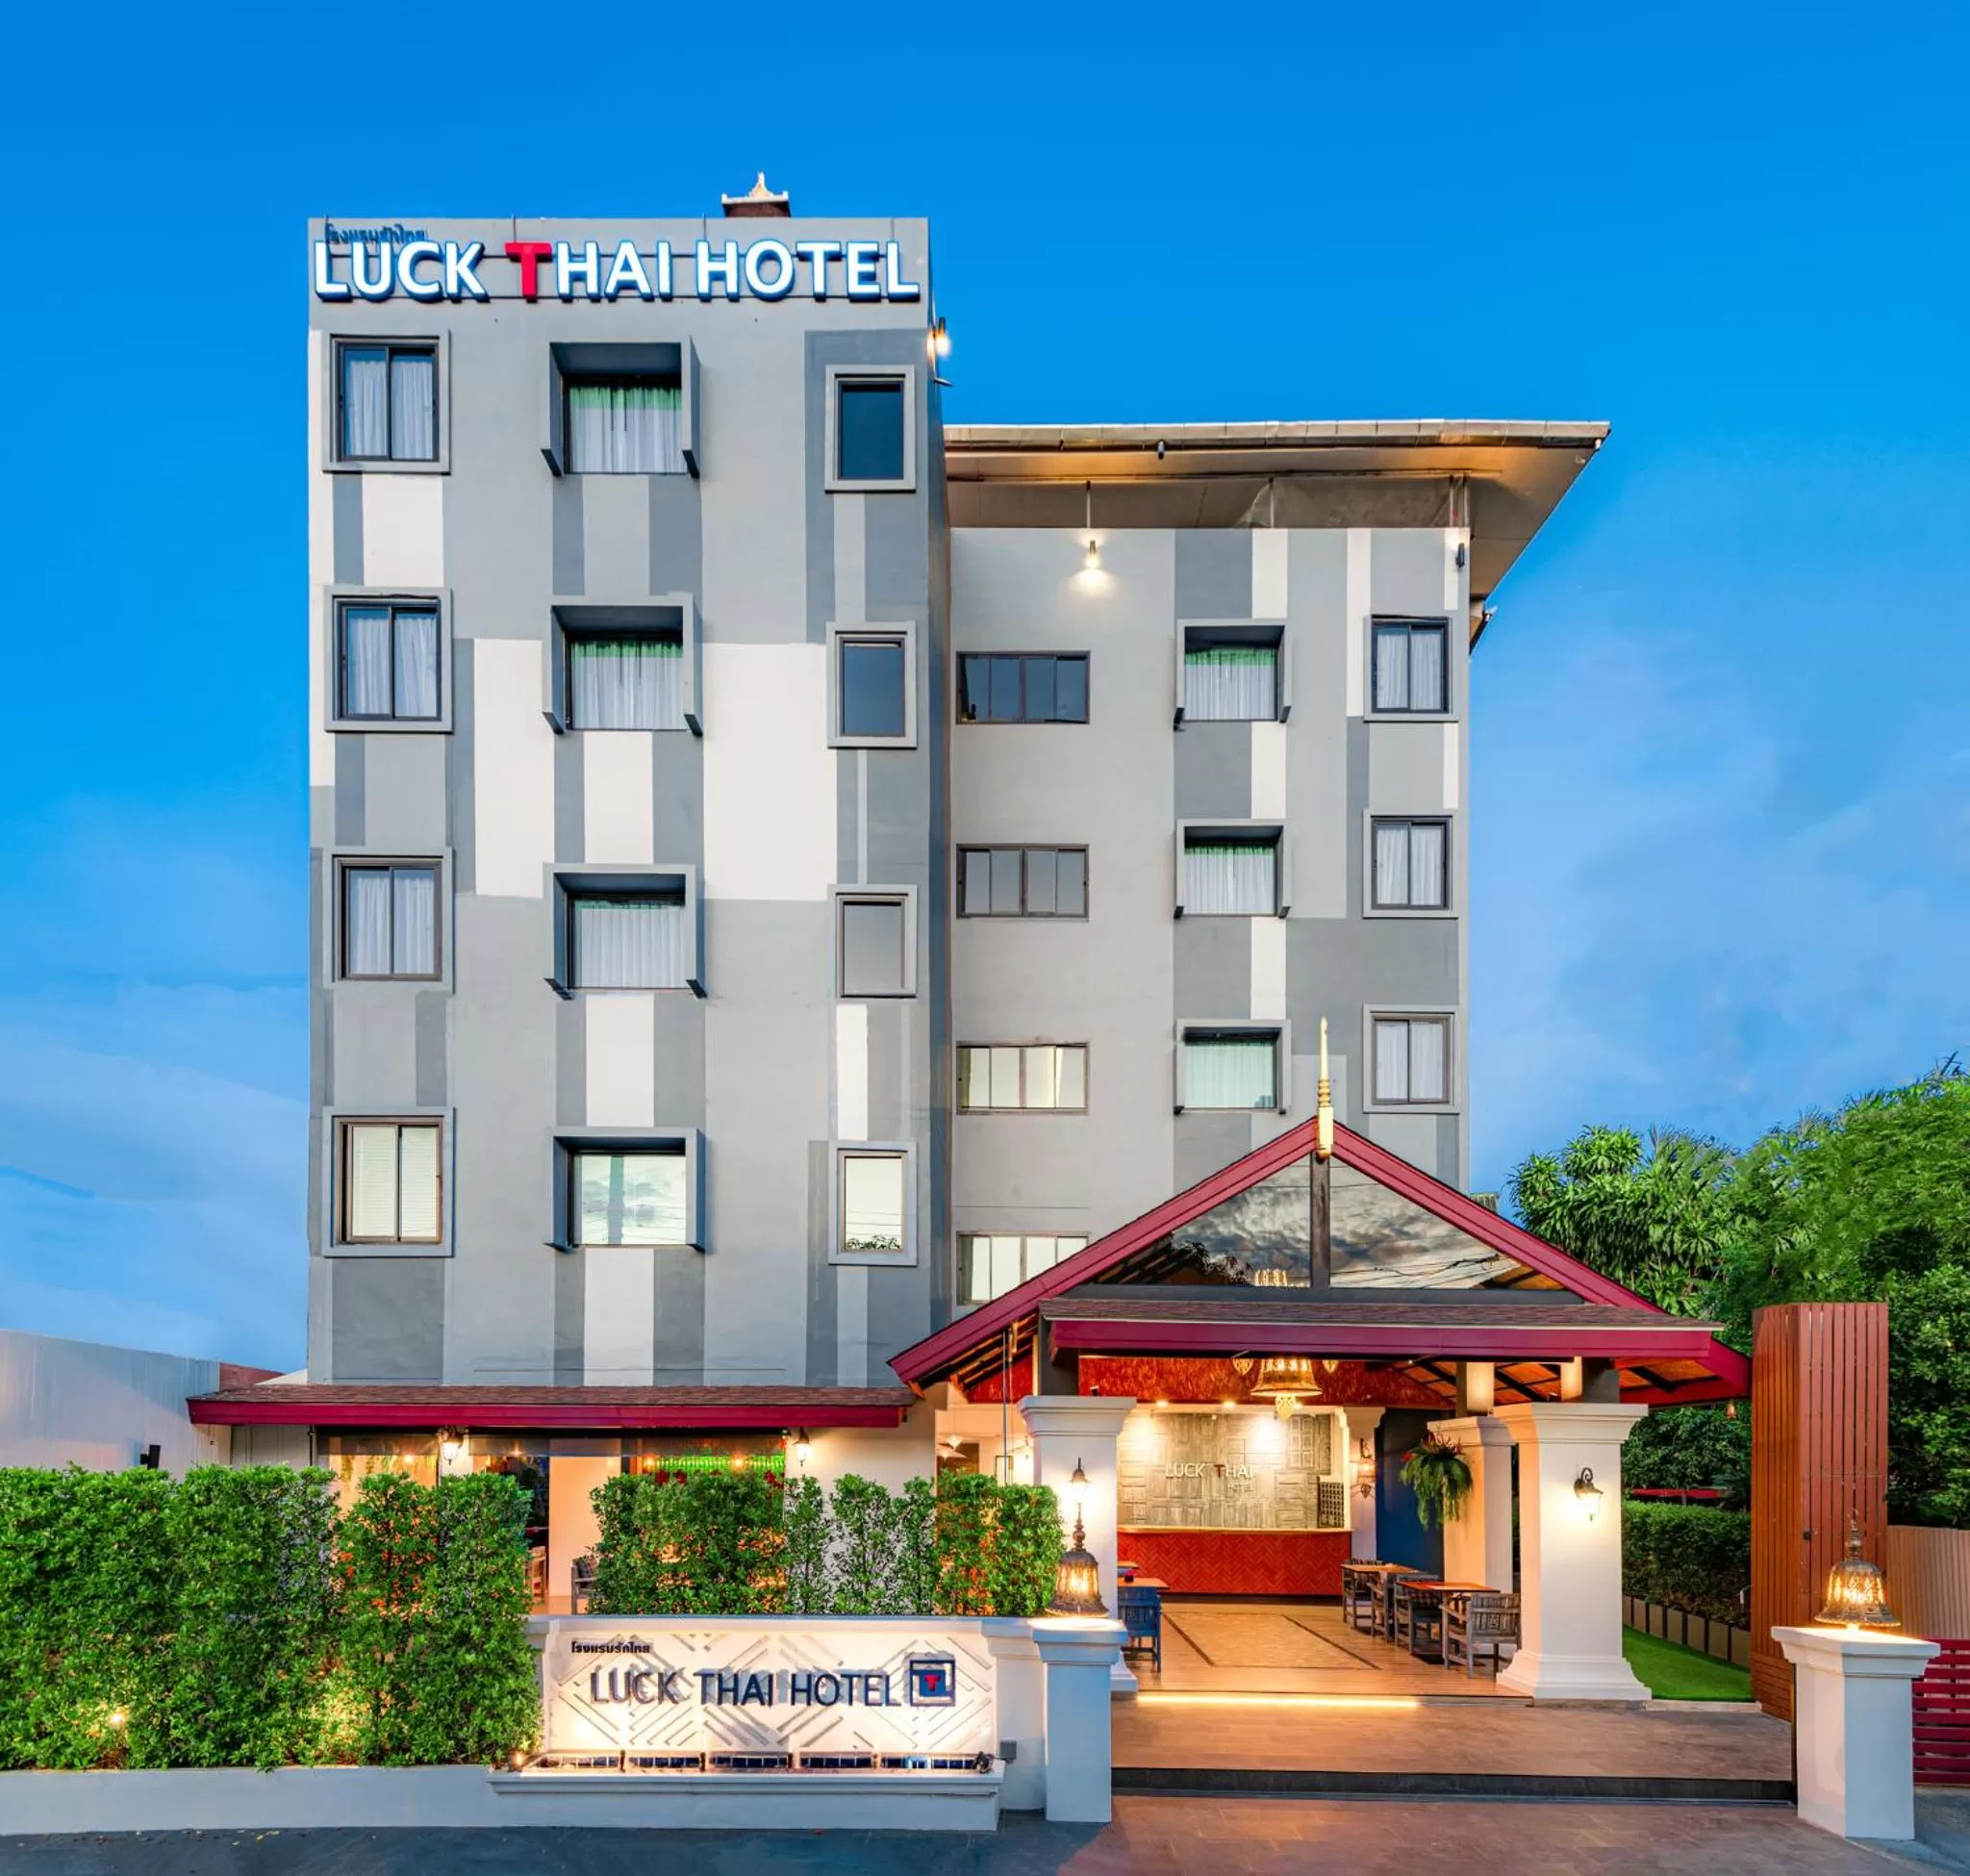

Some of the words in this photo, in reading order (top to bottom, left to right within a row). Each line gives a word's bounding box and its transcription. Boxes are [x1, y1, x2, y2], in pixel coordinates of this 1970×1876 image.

[314, 240, 489, 303] LUCK
[505, 241, 670, 303] THAI
[695, 241, 921, 303] HOTEL
[1165, 1463, 1205, 1479] LUCK
[1213, 1463, 1254, 1479] THAI
[590, 1671, 677, 1706] LUCK
[694, 1671, 773, 1707] THAI
[790, 1672, 901, 1707] HOTEL
